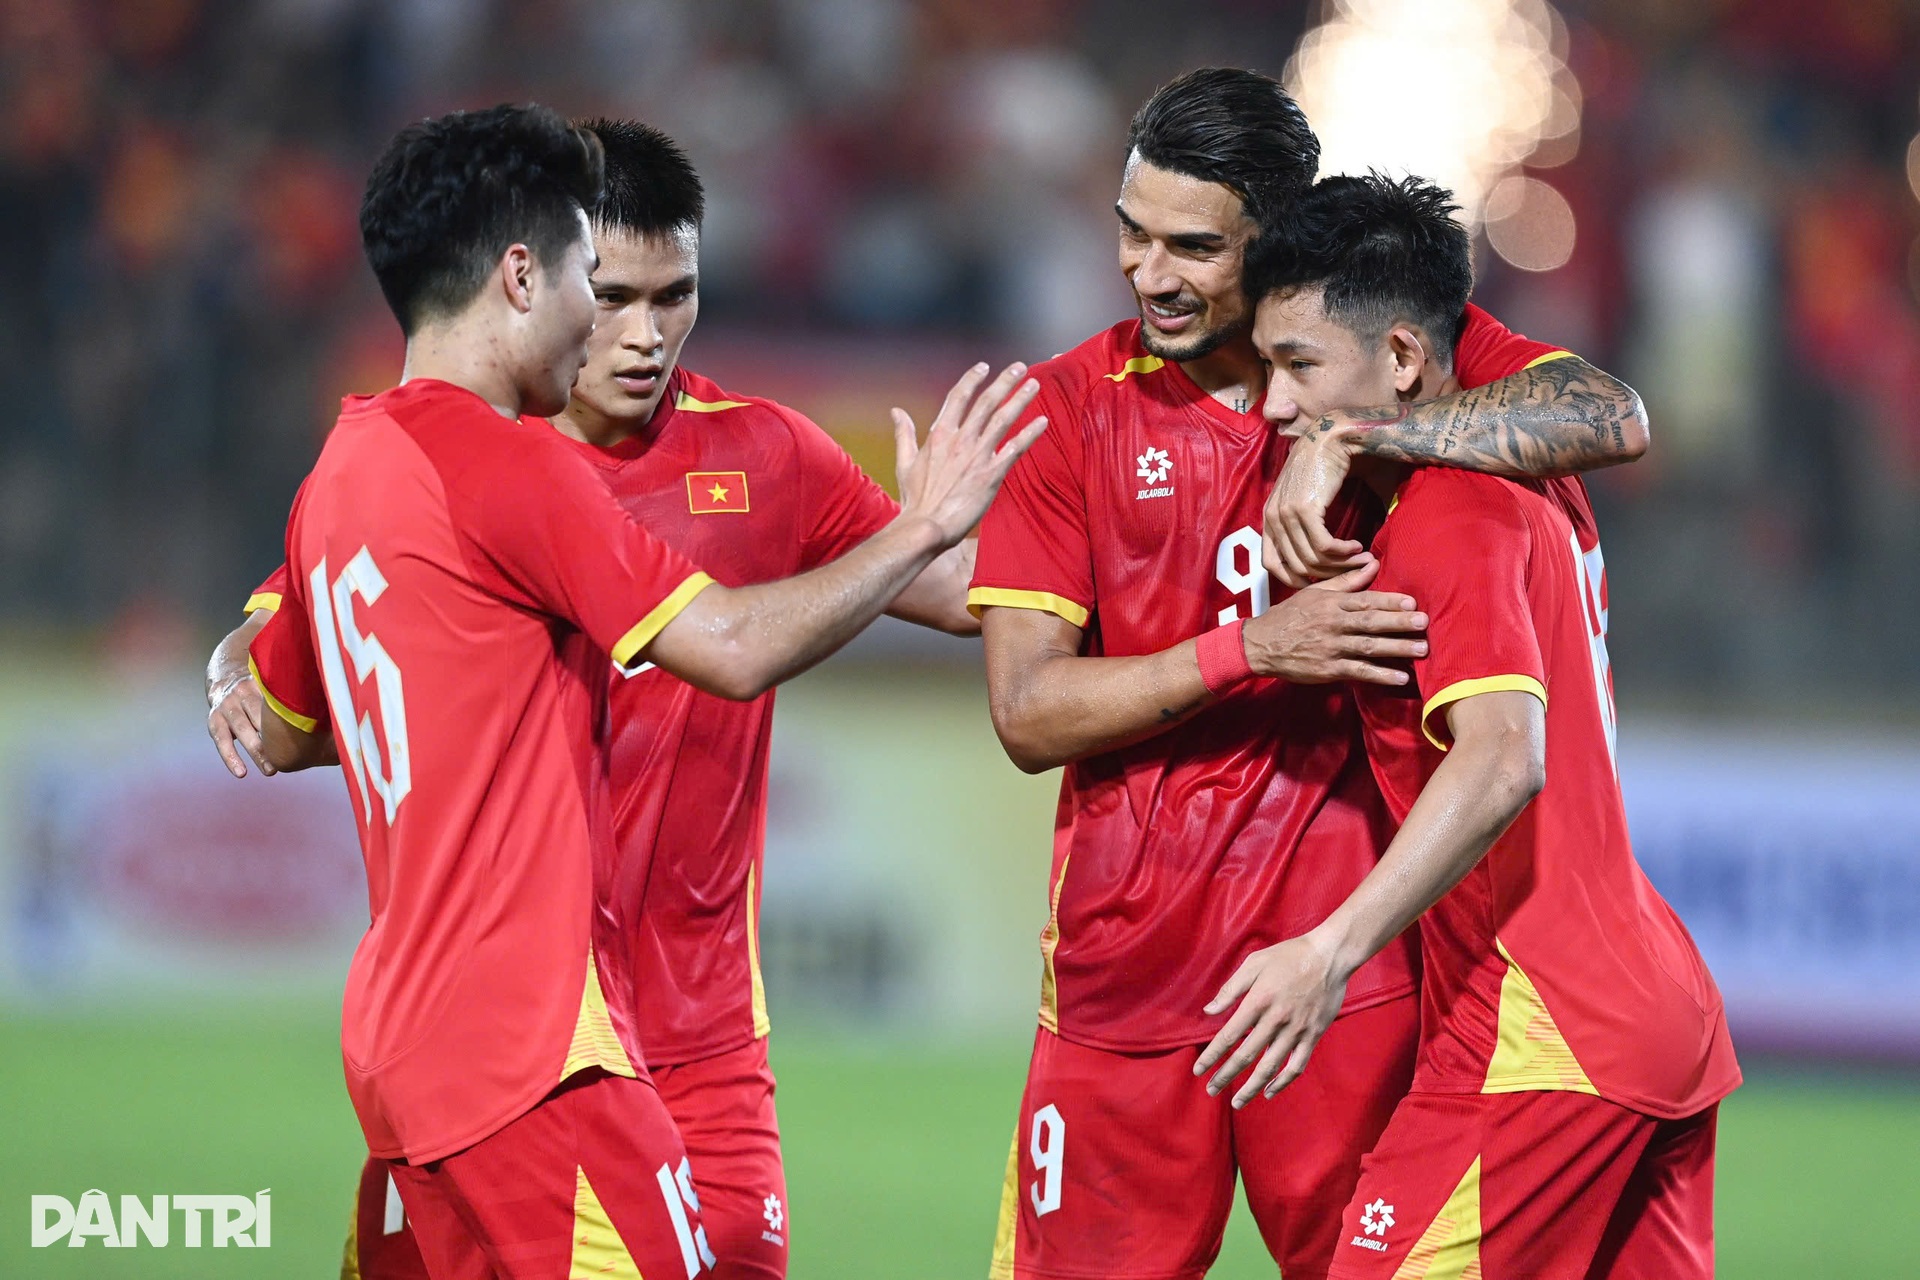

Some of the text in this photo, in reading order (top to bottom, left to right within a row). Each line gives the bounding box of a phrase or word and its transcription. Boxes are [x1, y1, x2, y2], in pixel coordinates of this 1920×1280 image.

[1215, 525, 1271, 627] 9
[309, 544, 412, 831] 15
[1030, 1103, 1066, 1218] 9
